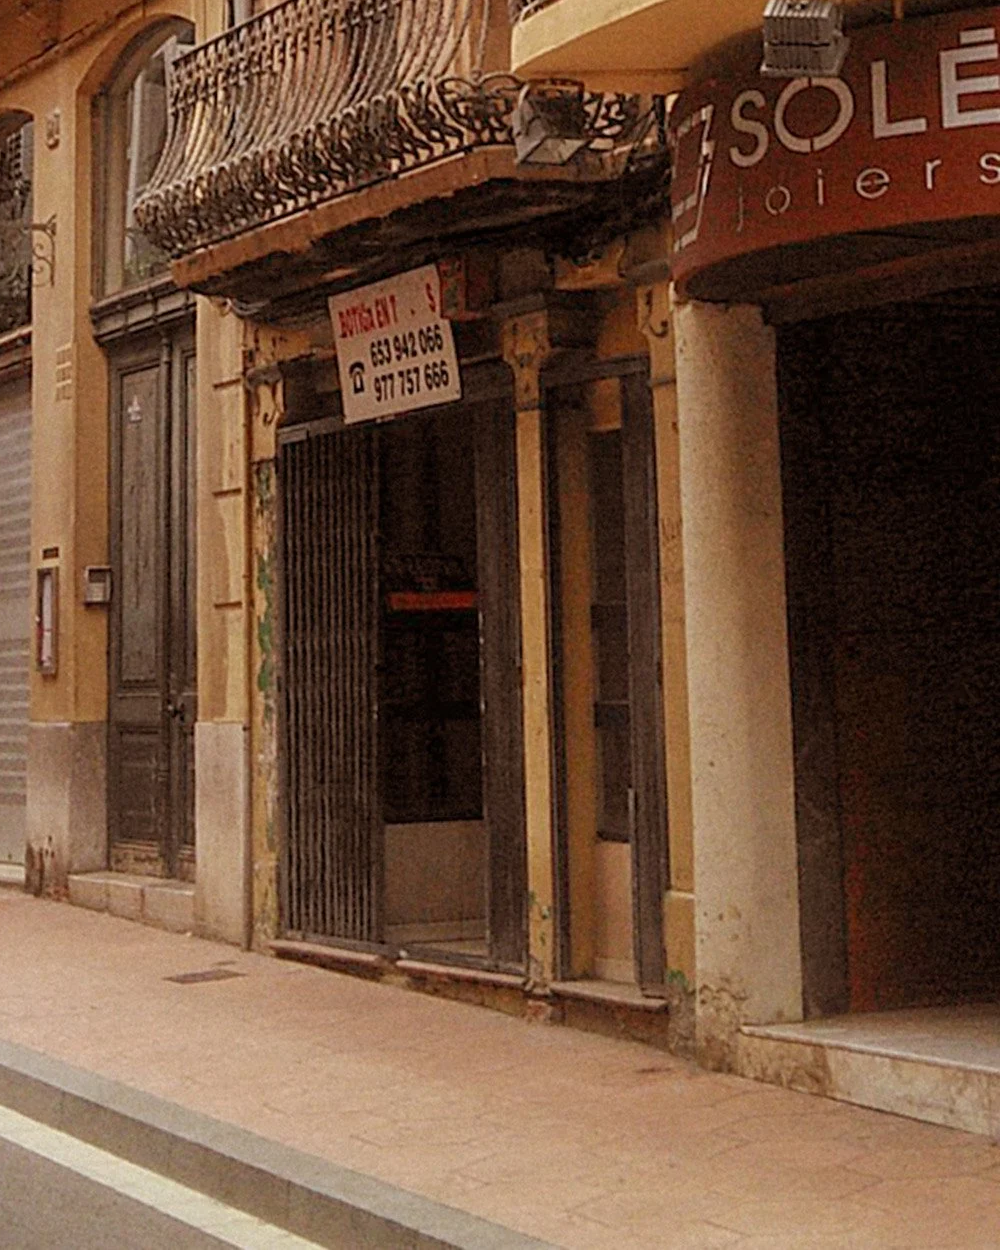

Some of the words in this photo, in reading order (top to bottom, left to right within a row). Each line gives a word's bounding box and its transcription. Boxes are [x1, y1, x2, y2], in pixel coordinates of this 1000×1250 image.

[370, 337, 392, 368] 653
[393, 331, 417, 363] 942
[374, 372, 395, 402] 977
[397, 366, 421, 396] 757
